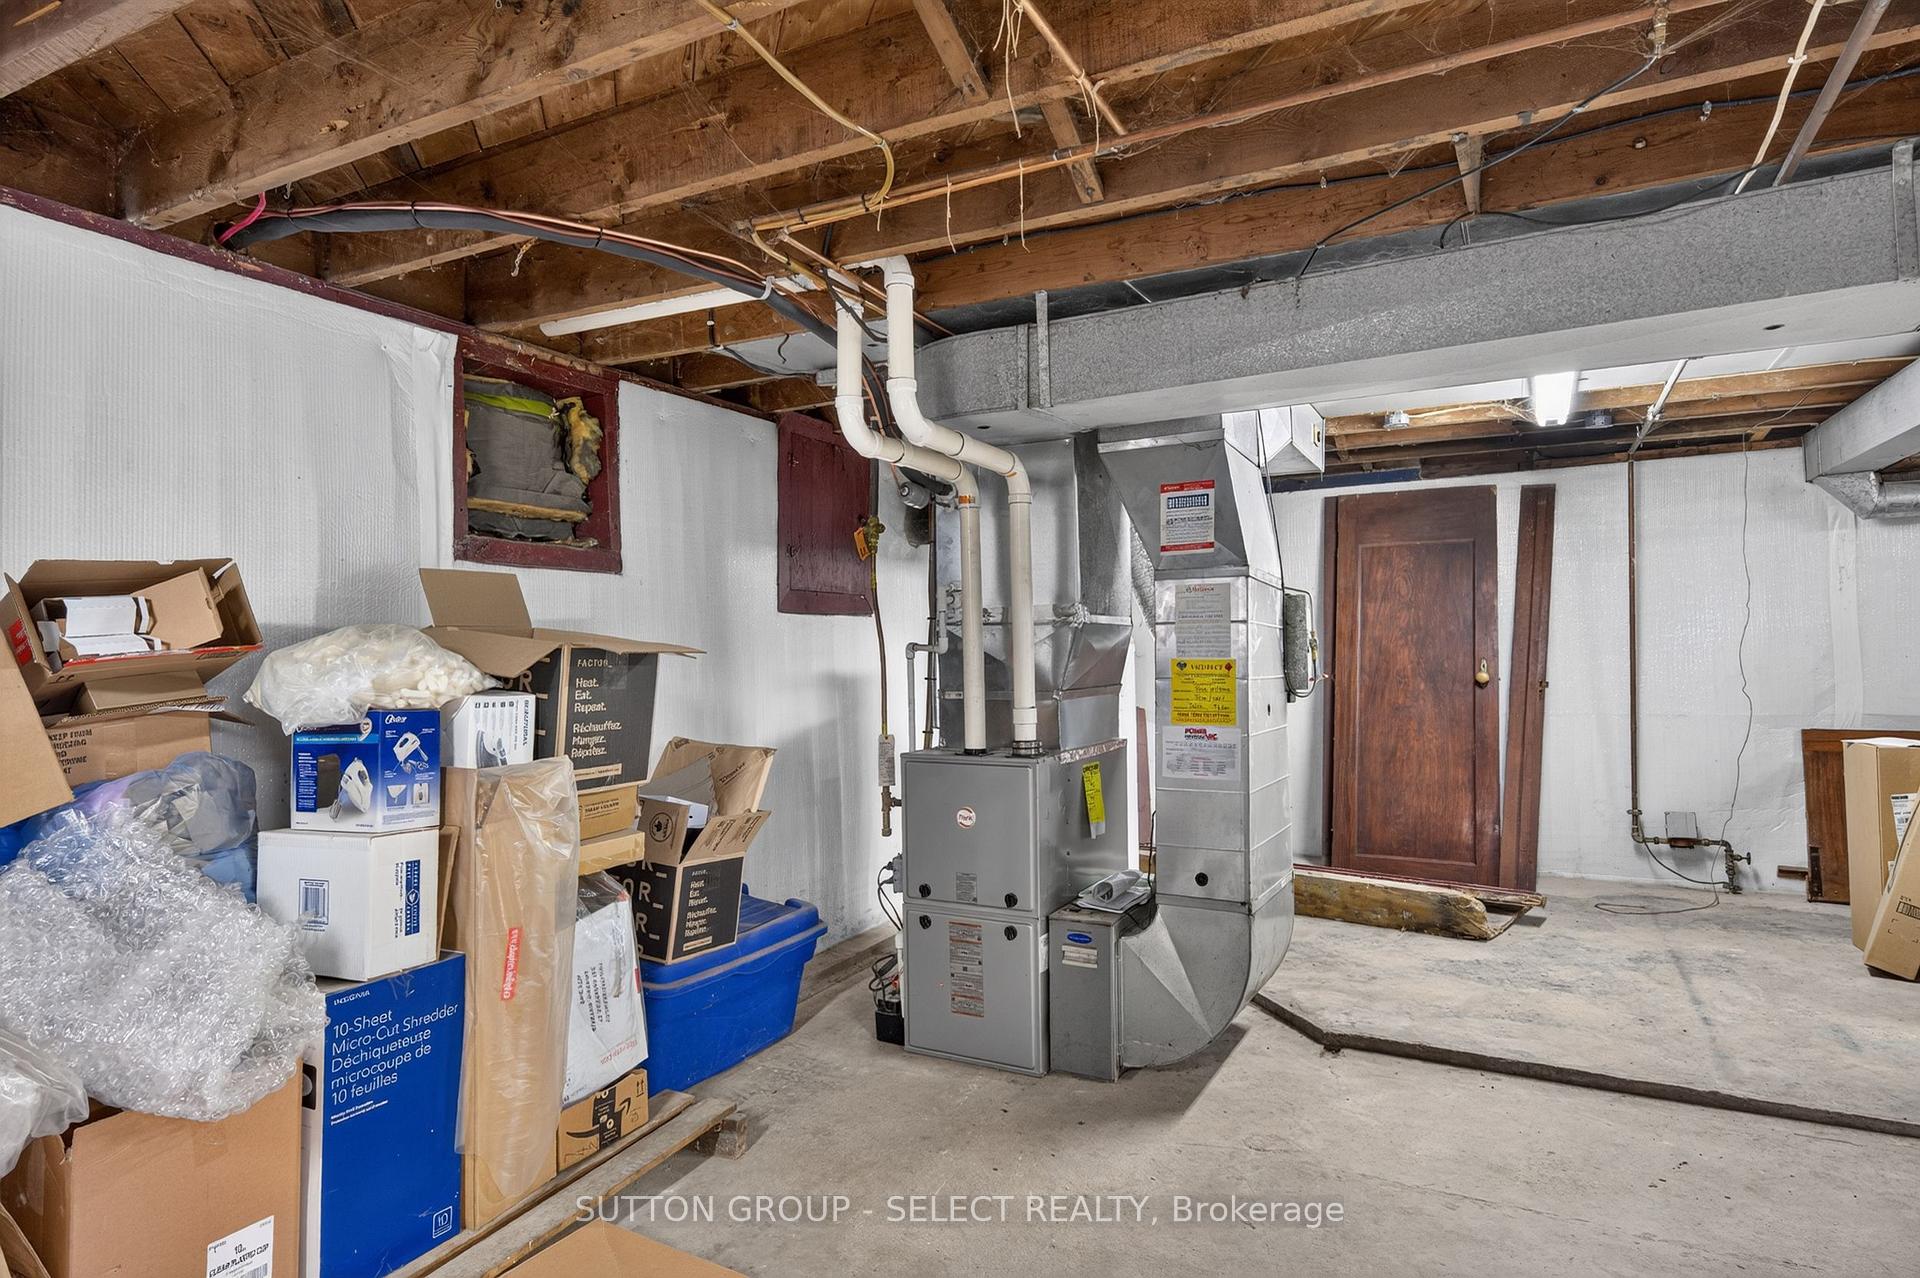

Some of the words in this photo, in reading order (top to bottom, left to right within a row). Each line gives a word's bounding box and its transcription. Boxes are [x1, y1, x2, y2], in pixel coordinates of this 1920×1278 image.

[575, 690, 592, 700] Eat.
[576, 678, 599, 688] Heat.
[574, 702, 607, 714] Repeat.
[332, 1023, 400, 1056] Micro-Cut
[403, 1003, 458, 1032] Shredder
[333, 1009, 393, 1038] 10-Sheet
[331, 1028, 432, 1073] Déchiqueteuse
[331, 1052, 412, 1090] microcoupe
[415, 1041, 432, 1058] de
[331, 1089, 348, 1106] 10
[351, 1072, 398, 1098] feuilles
